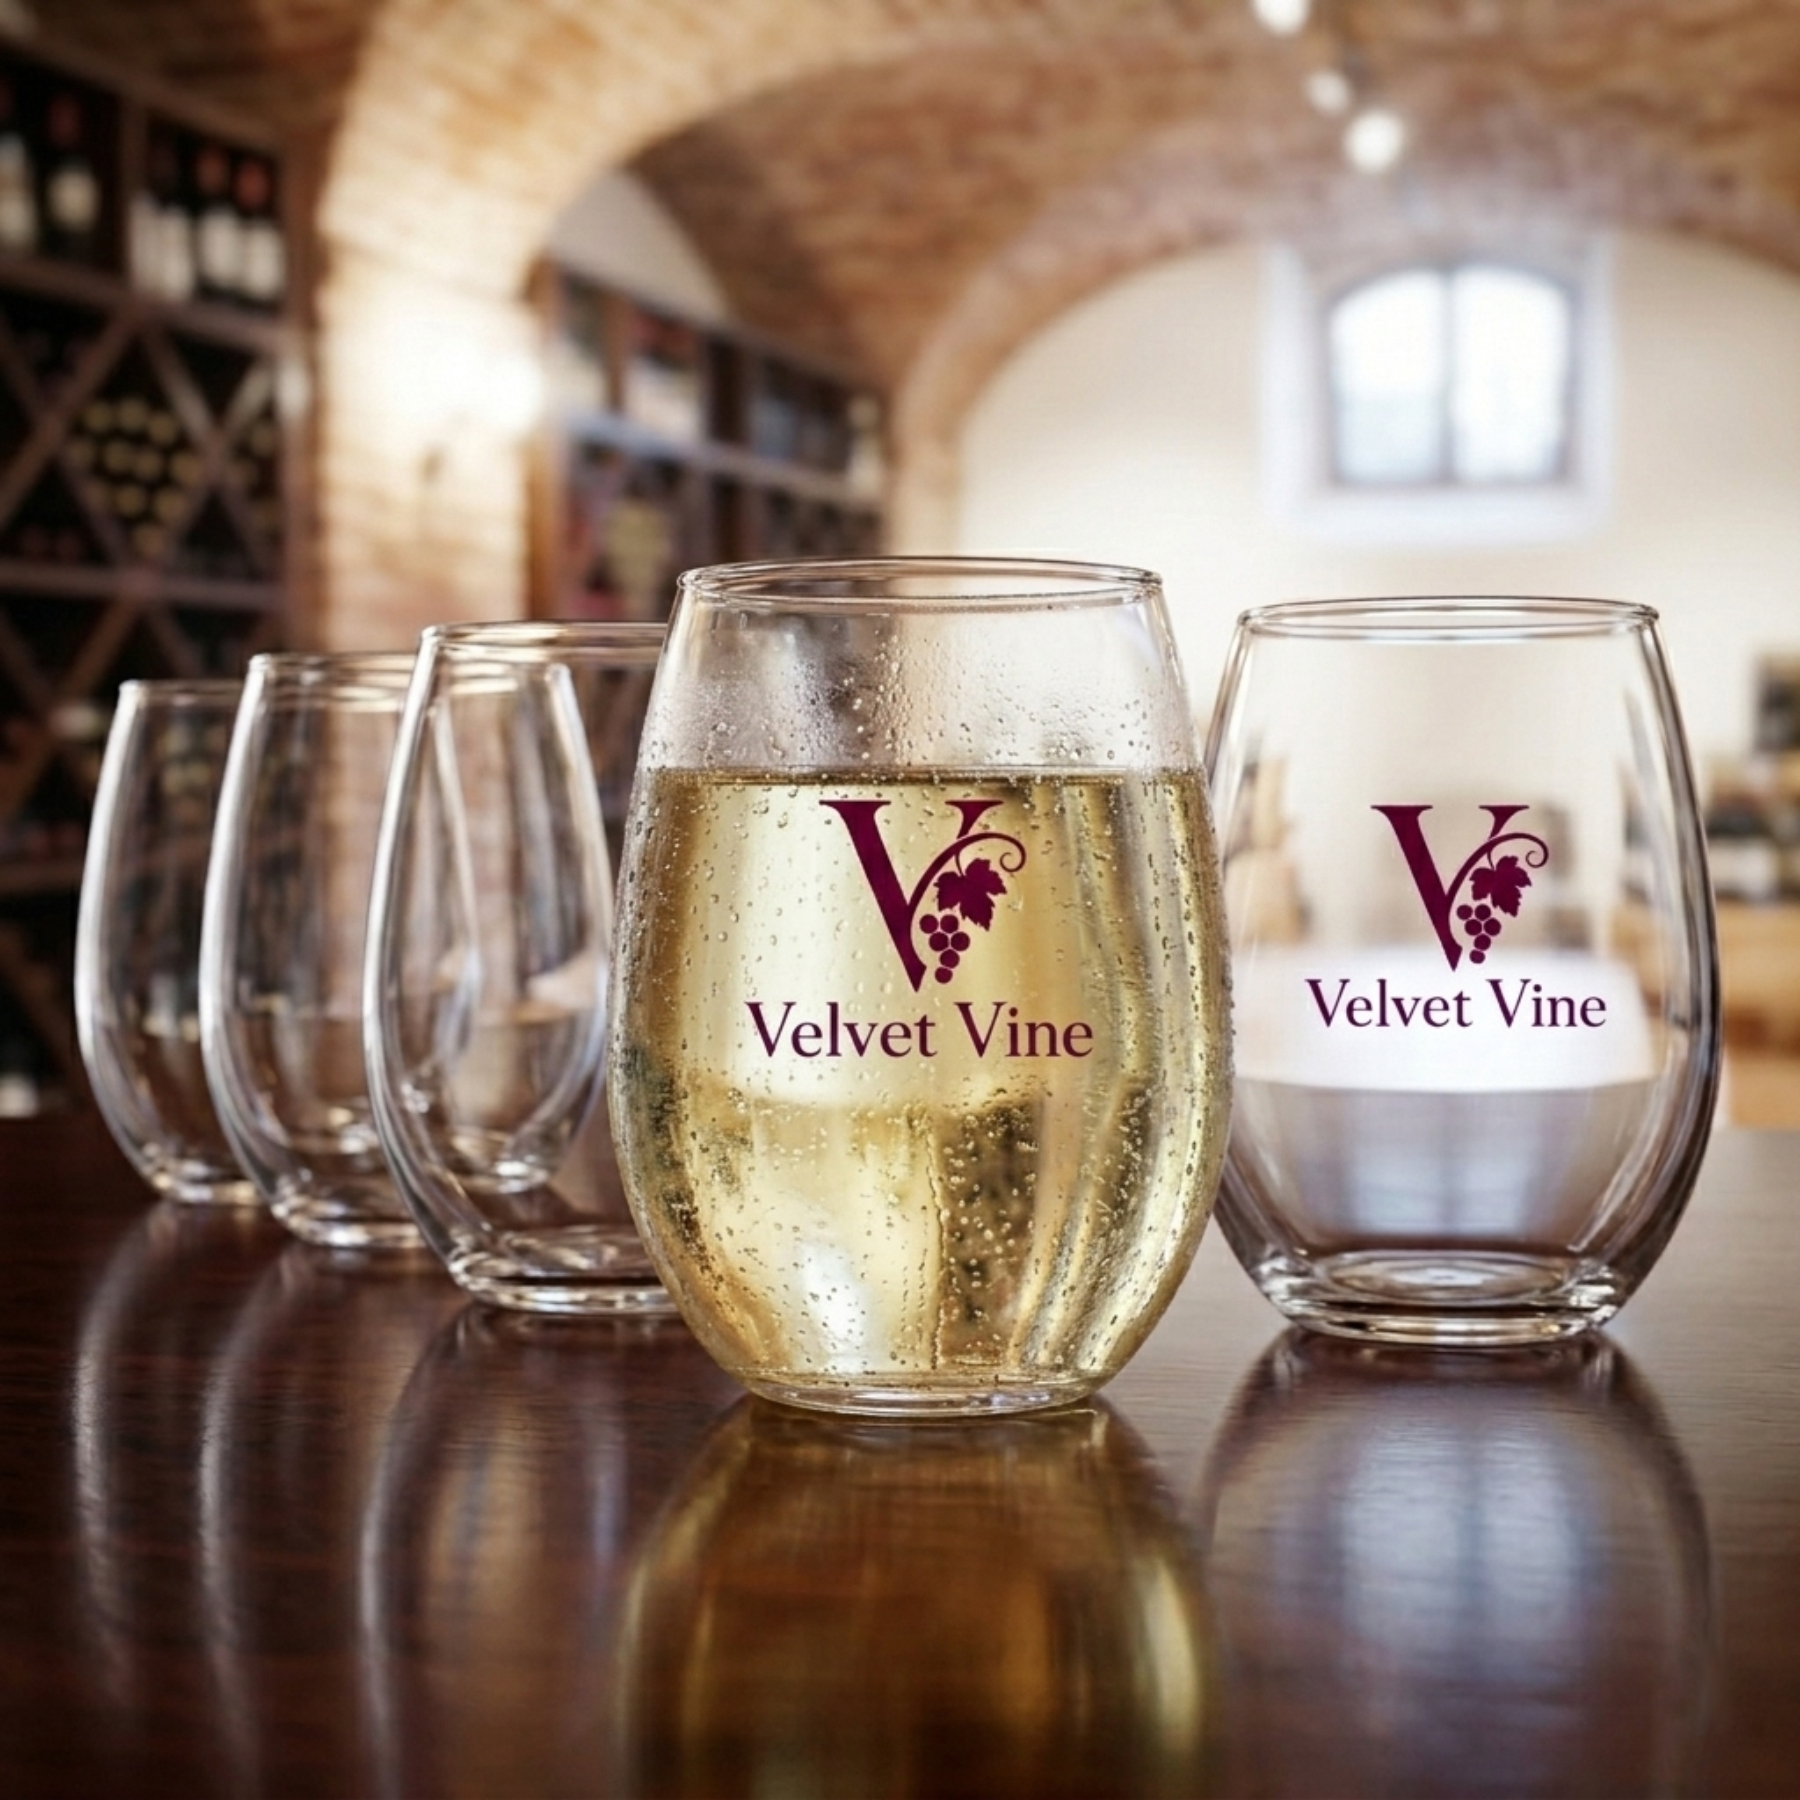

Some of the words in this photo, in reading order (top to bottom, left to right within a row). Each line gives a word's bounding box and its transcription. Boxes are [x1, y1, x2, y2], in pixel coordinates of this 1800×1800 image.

[818, 799, 1026, 993] V
[1371, 804, 1549, 971] V
[745, 1001, 938, 1058] Velvet
[954, 1001, 1094, 1058] Vine
[1305, 978, 1473, 1028] Velvet
[1485, 978, 1607, 1028] Vine
